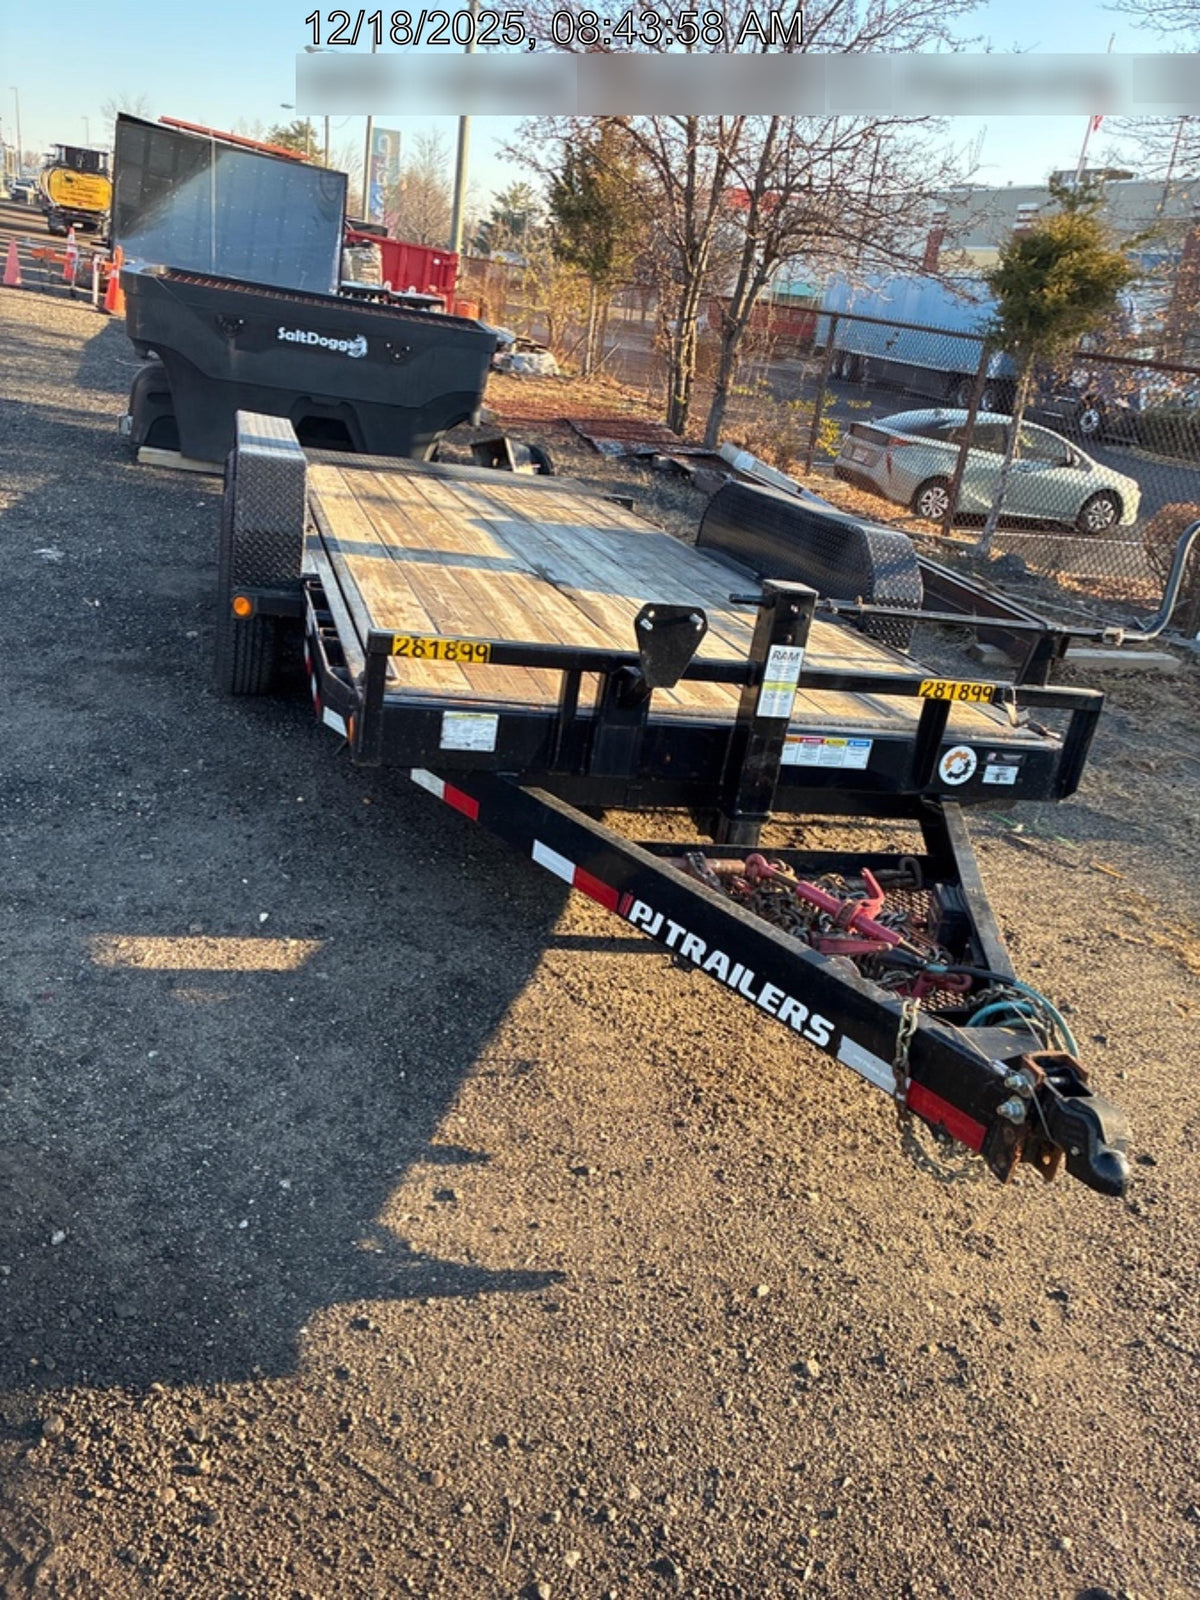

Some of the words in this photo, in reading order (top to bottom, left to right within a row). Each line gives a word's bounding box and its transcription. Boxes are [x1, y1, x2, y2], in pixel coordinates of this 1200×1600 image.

[277, 326, 348, 352] SaltDogg
[394, 636, 489, 664] 281899
[771, 649, 801, 661] RAM
[920, 680, 994, 703] 281899
[628, 899, 665, 936] PJ
[665, 919, 836, 1048] TRAILERS
